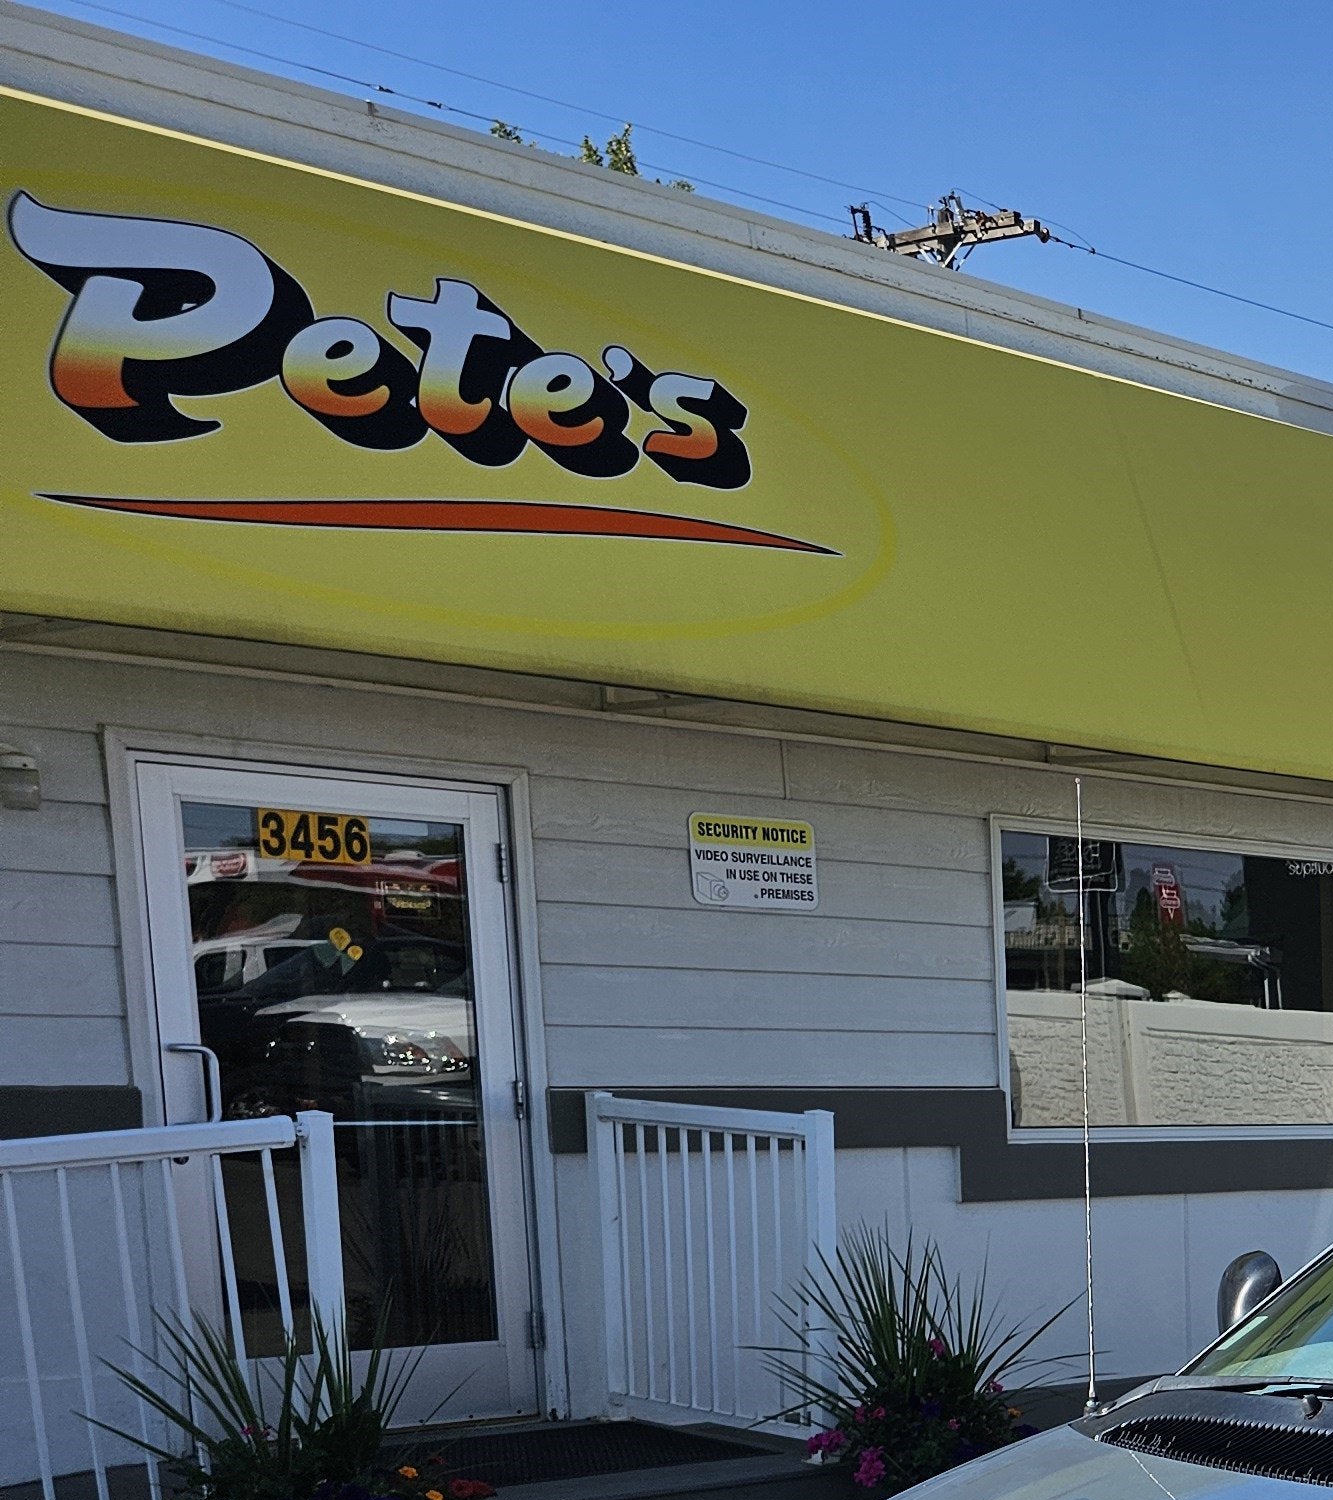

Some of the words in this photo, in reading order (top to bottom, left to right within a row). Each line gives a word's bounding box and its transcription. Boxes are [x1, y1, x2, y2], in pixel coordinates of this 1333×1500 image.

[8, 188, 752, 489] Pete's
[261, 811, 368, 862] 3456
[697, 821, 758, 840] SECURITY
[762, 826, 807, 844] NOTICE
[695, 849, 728, 862] VIDEO
[731, 851, 812, 868] SURVEILLANCE
[726, 868, 736, 879] IN
[739, 869, 760, 881] USE
[762, 871, 777, 882] ON
[780, 872, 813, 885] THESE
[760, 888, 814, 901] PREMISES
